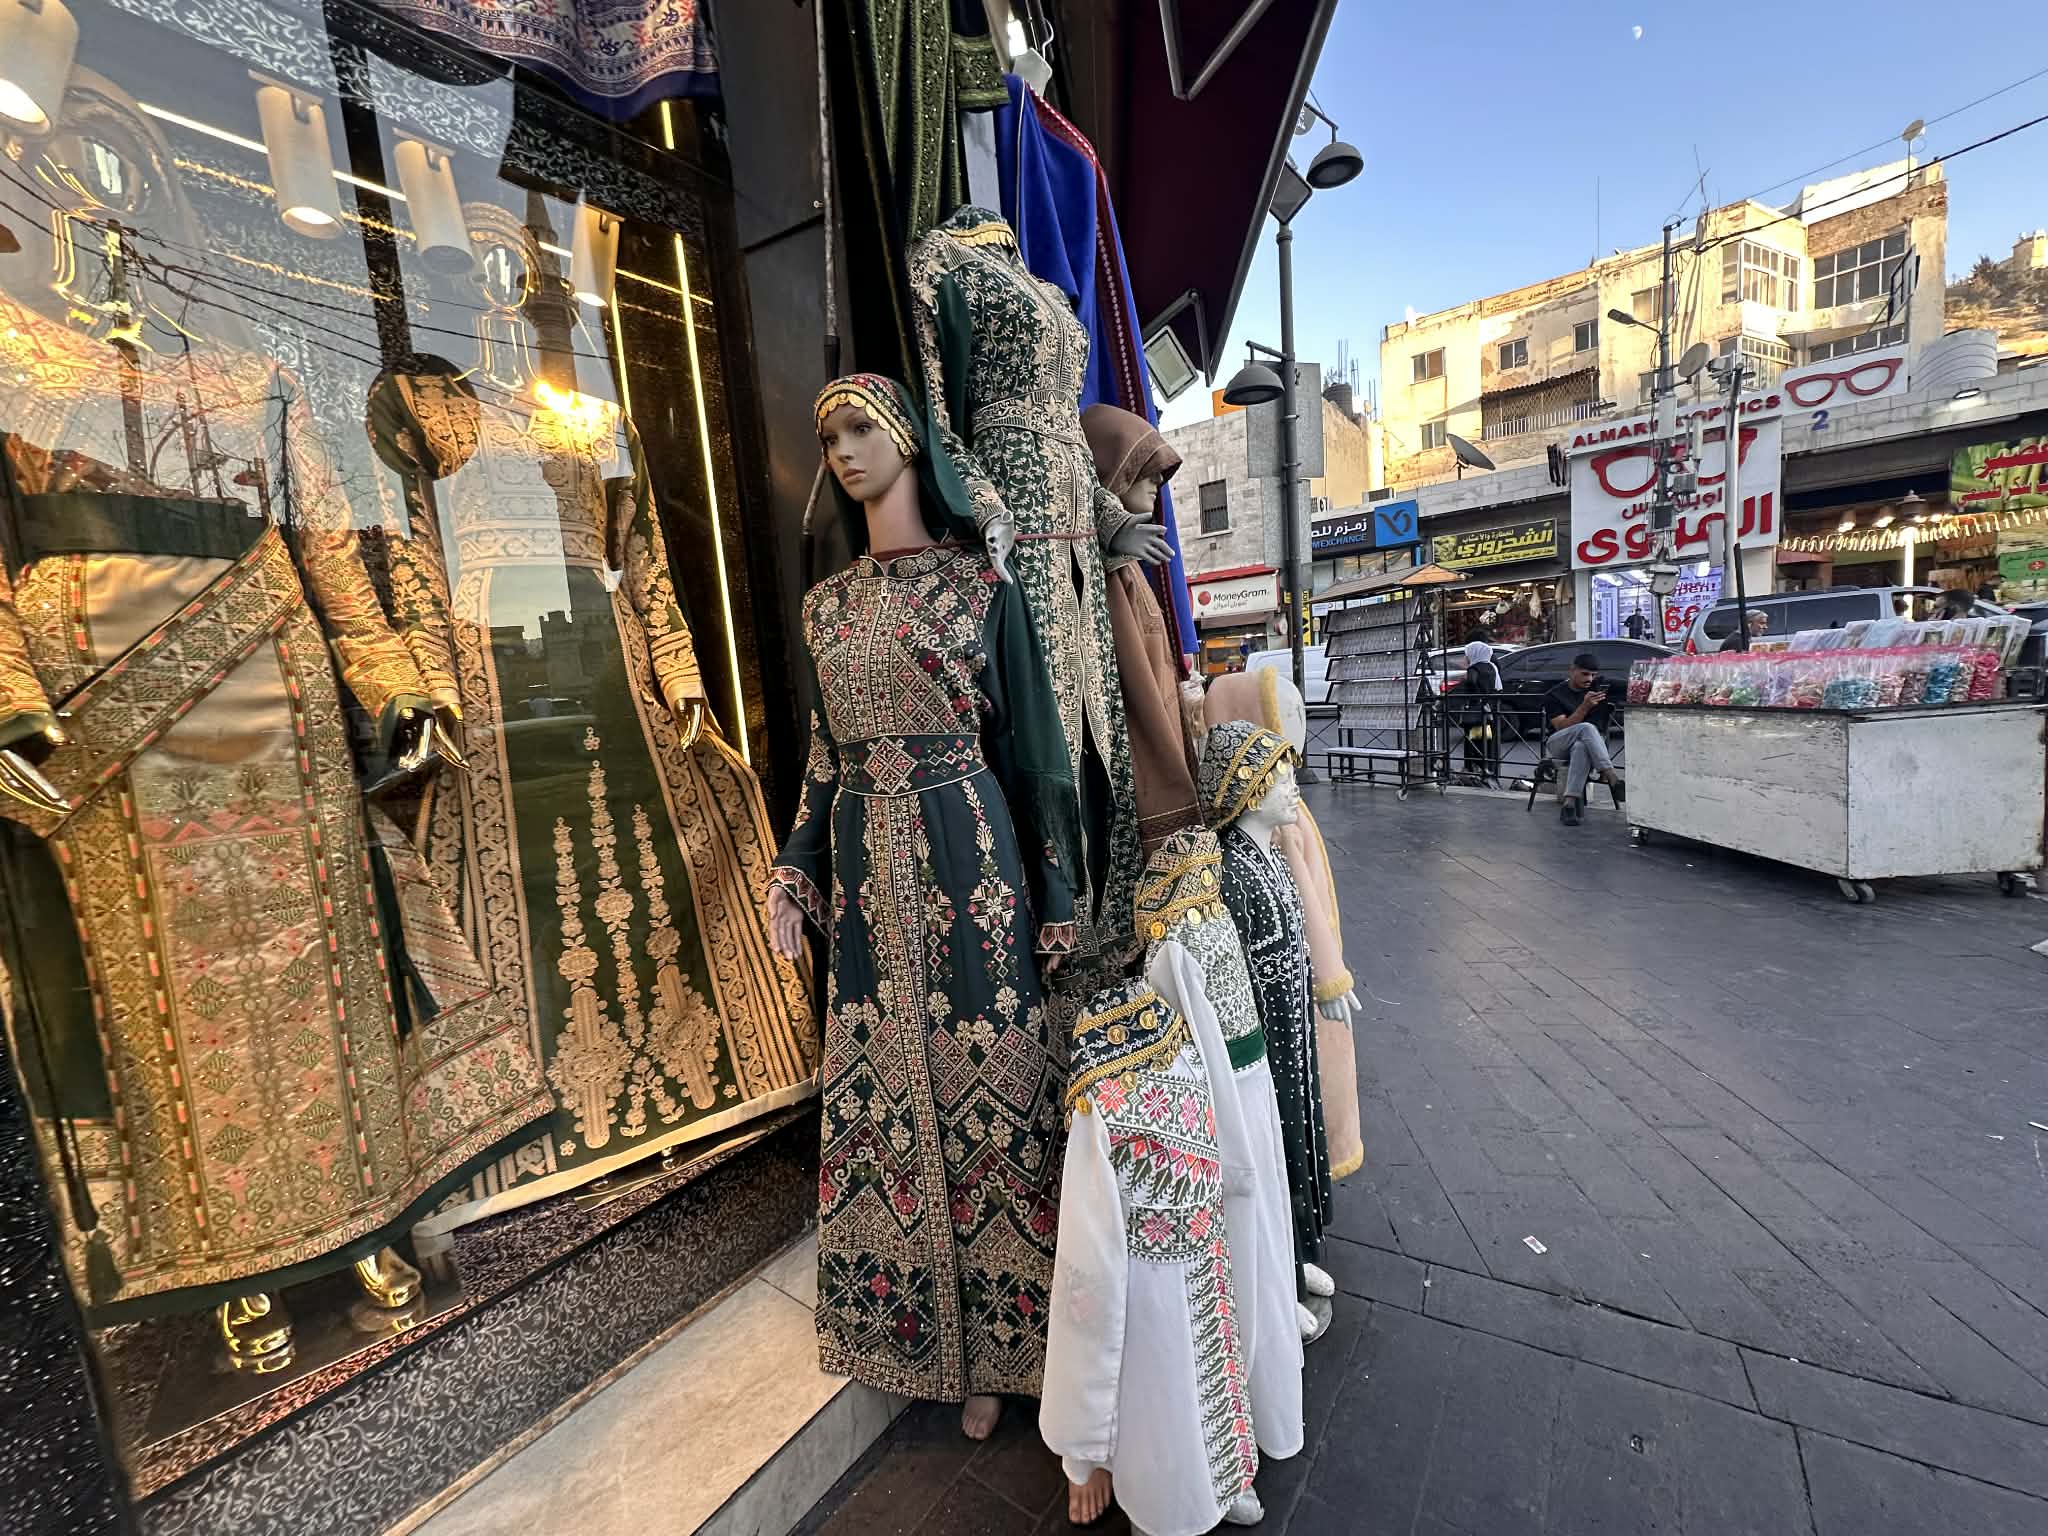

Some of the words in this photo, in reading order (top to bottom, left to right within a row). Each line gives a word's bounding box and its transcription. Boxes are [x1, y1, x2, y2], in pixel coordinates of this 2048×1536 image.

[1572, 415, 1687, 449] ALMAR
[1690, 394, 1781, 423] OPICS
[1812, 409, 1830, 432] 2
[1334, 518, 1367, 537] زمزم
[1213, 588, 1267, 602] MoneyGram
